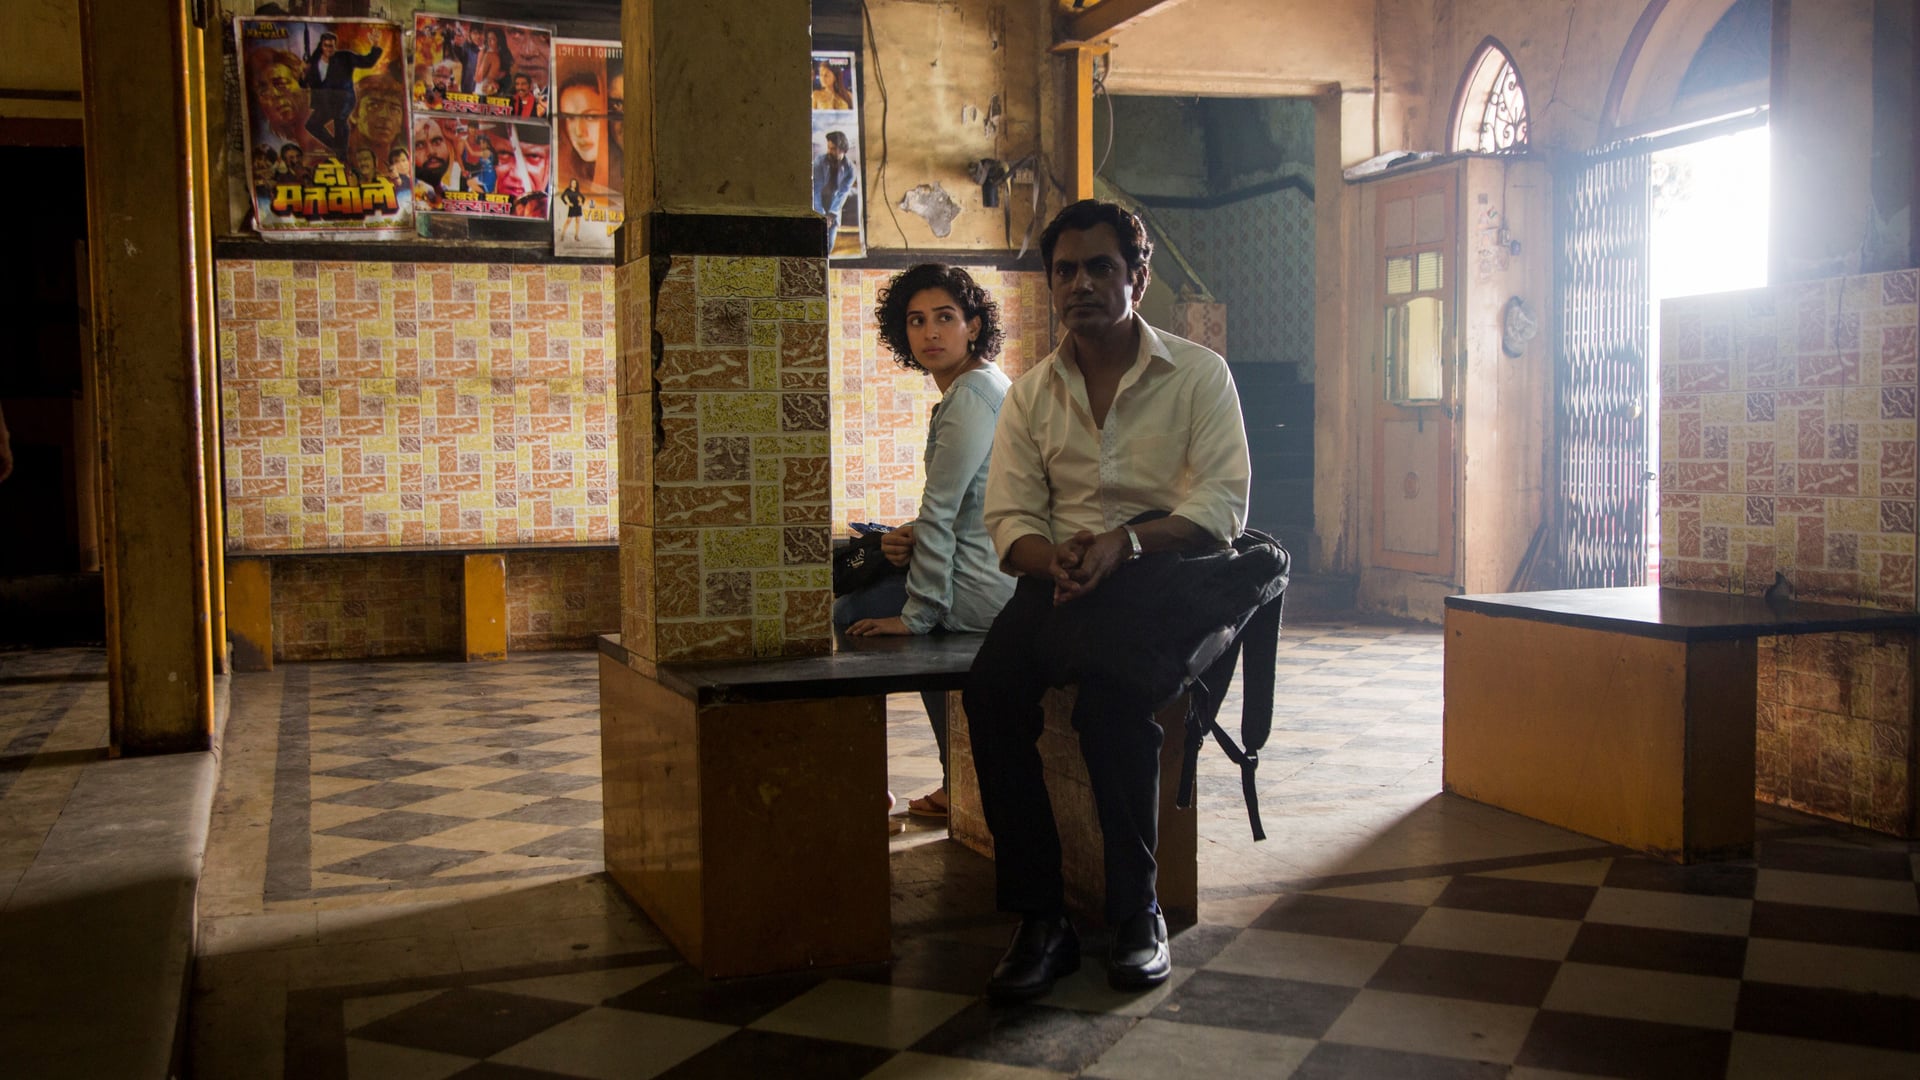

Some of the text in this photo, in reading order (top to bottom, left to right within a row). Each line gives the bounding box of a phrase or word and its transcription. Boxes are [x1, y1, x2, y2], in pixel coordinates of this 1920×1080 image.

[313, 157, 348, 187] दो
[271, 176, 398, 217] मतवाले
[583, 208, 607, 222] YEH
